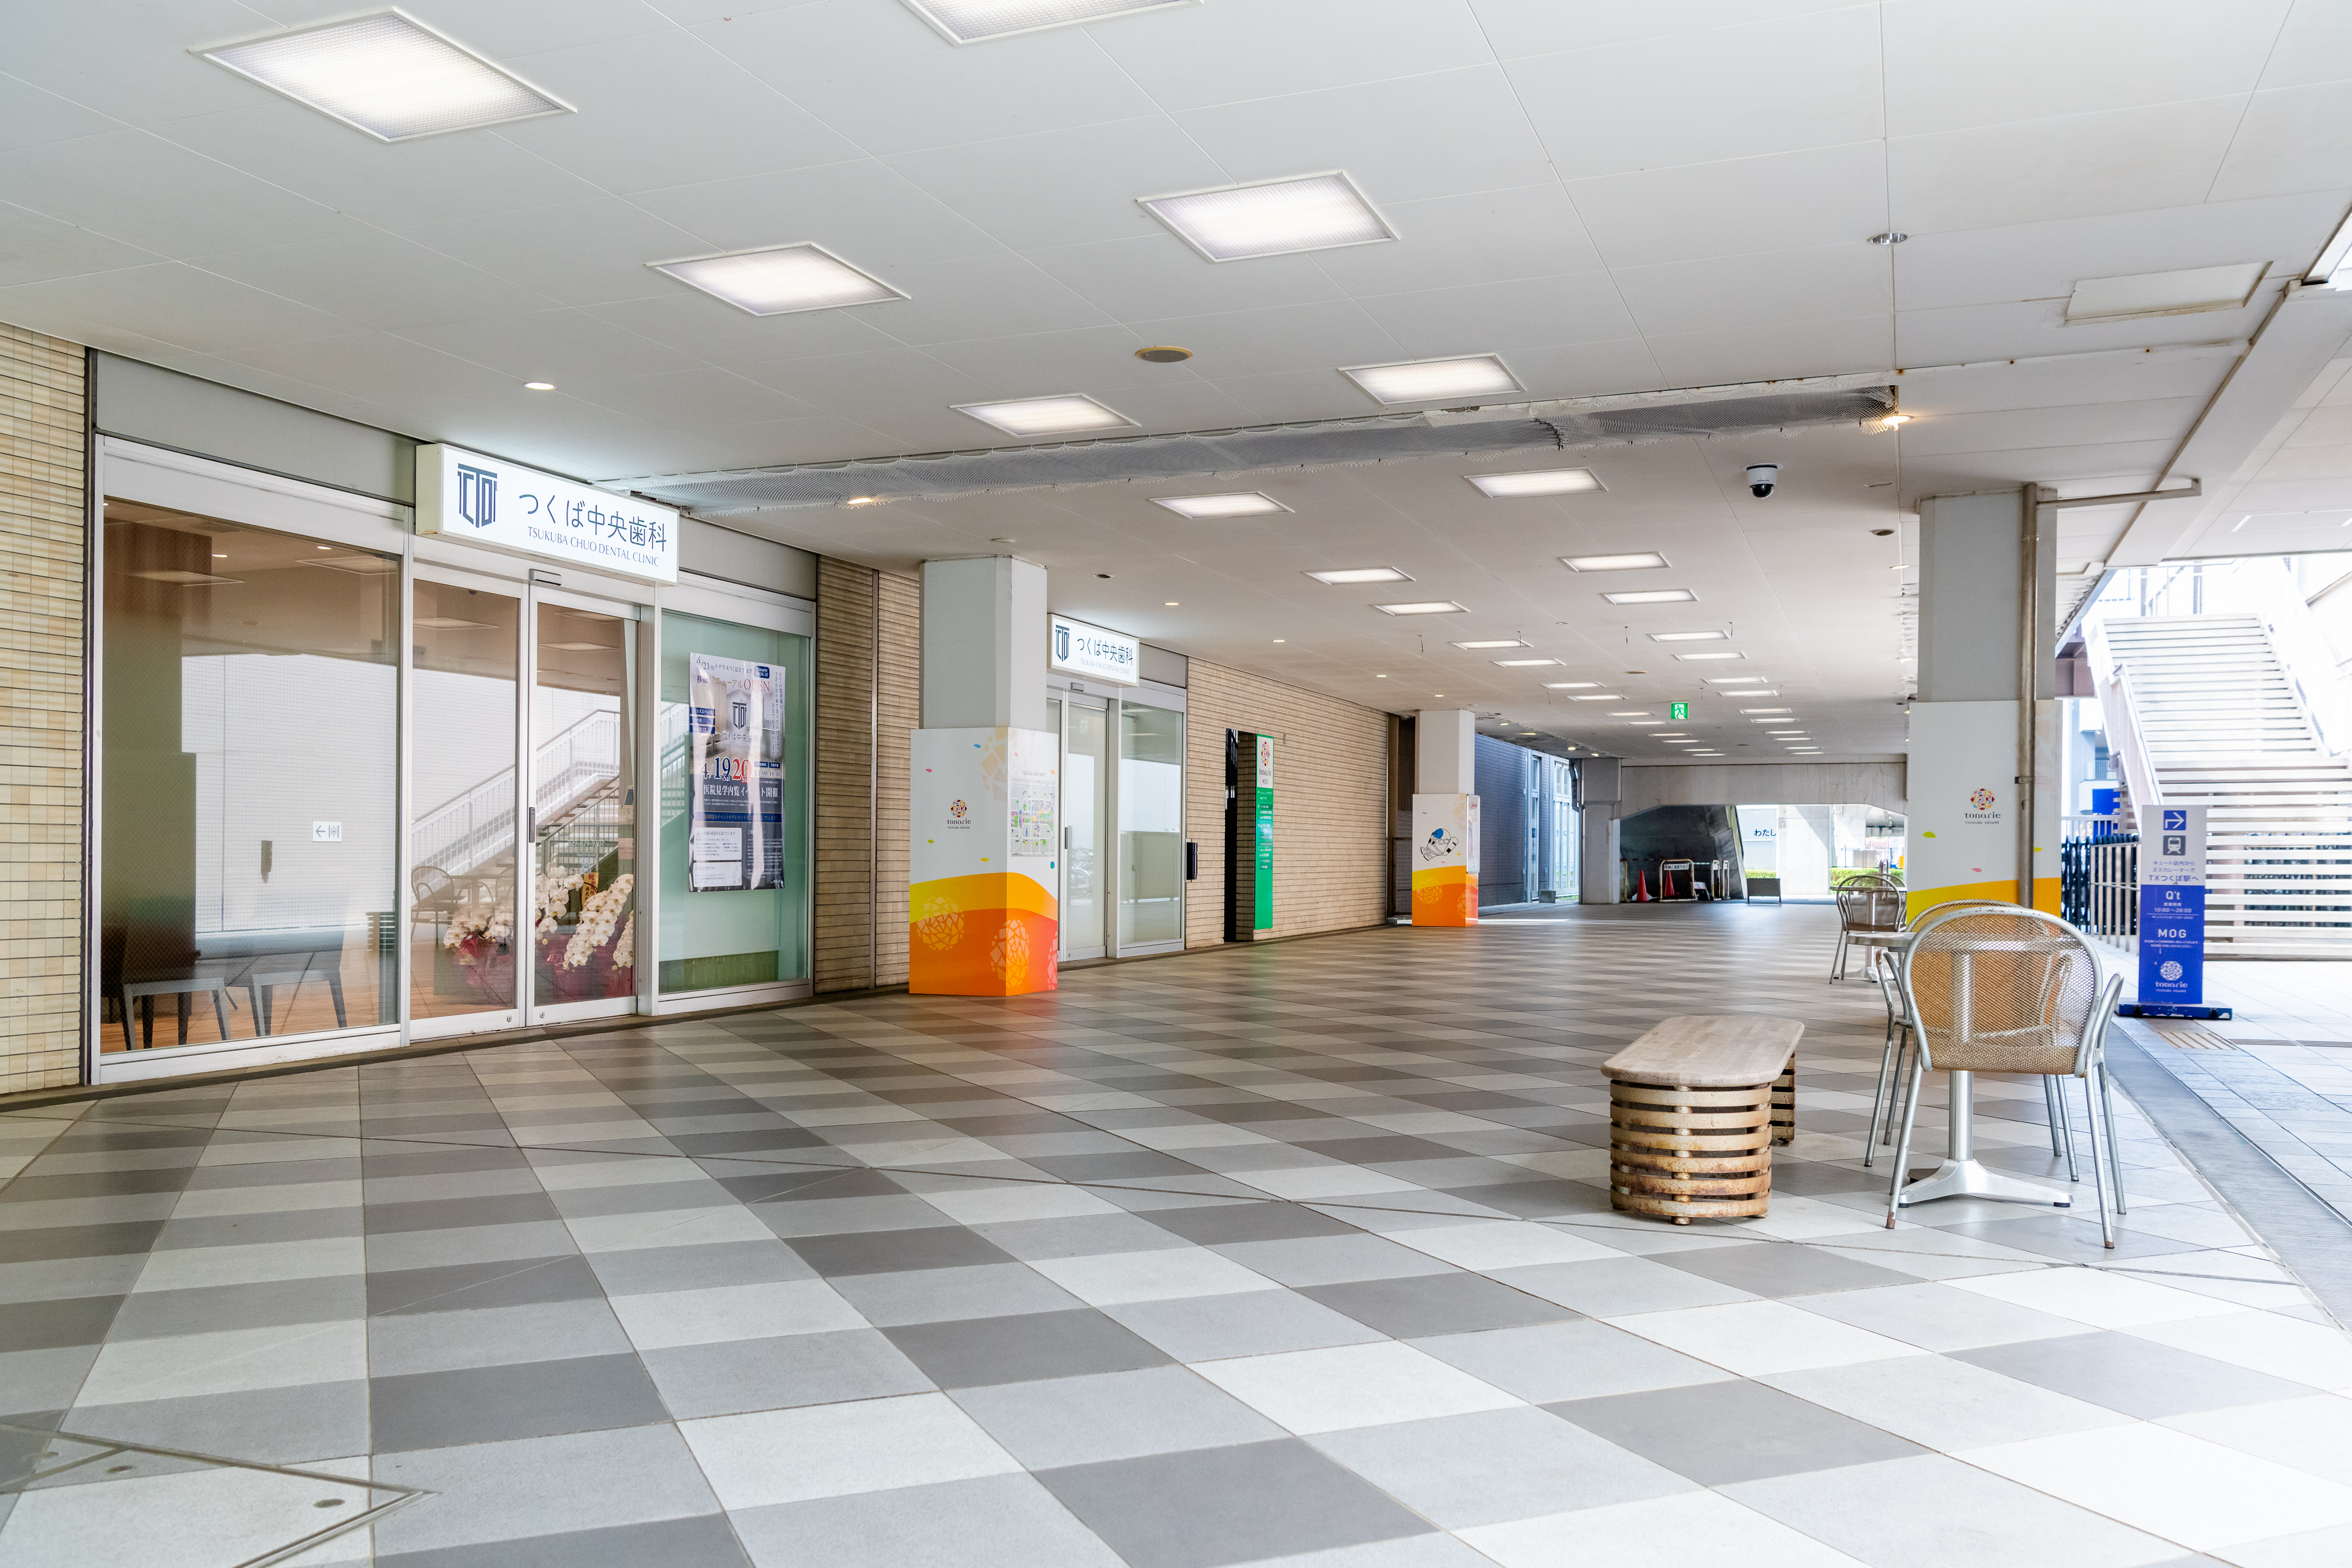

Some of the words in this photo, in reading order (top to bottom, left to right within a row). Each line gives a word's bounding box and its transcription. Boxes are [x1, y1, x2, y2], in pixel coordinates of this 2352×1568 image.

[519, 494, 666, 551] つくば中央歯科
[527, 526, 568, 545] TSUKUBA
[570, 537, 597, 551] CHUO
[599, 543, 631, 560] DENTAL
[633, 552, 660, 567] CLINIC
[1077, 637, 1133, 666] つくば中央歯科
[1080, 657, 1095, 667] TSUKUBA
[1095, 661, 1107, 670] CHUO
[1107, 664, 1119, 673] DENTAL
[1119, 667, 1130, 676] CLINIC
[1259, 768, 1272, 776] tonarie
[2158, 928, 2187, 938] MOG
